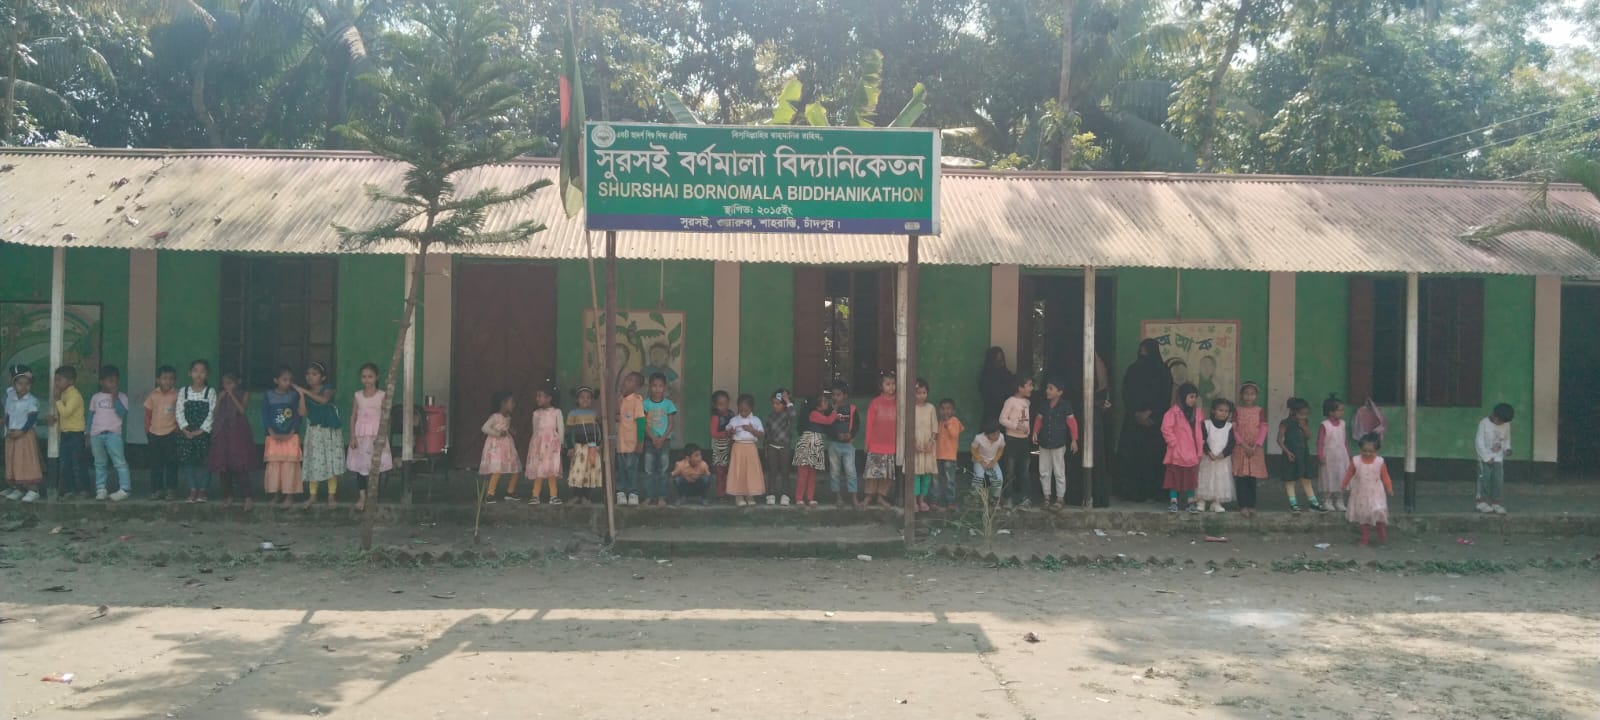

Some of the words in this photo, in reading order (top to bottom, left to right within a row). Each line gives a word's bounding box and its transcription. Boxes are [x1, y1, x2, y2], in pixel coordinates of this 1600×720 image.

[594, 142, 671, 181] সুরসই
[677, 143, 767, 177] বর্ণমালা
[773, 145, 926, 180] বিদ্যানিকেতন
[598, 181, 679, 199] SHURSHAI
[683, 183, 783, 201] BORNOMALA
[787, 186, 924, 203] BIDDHANIKATHON
